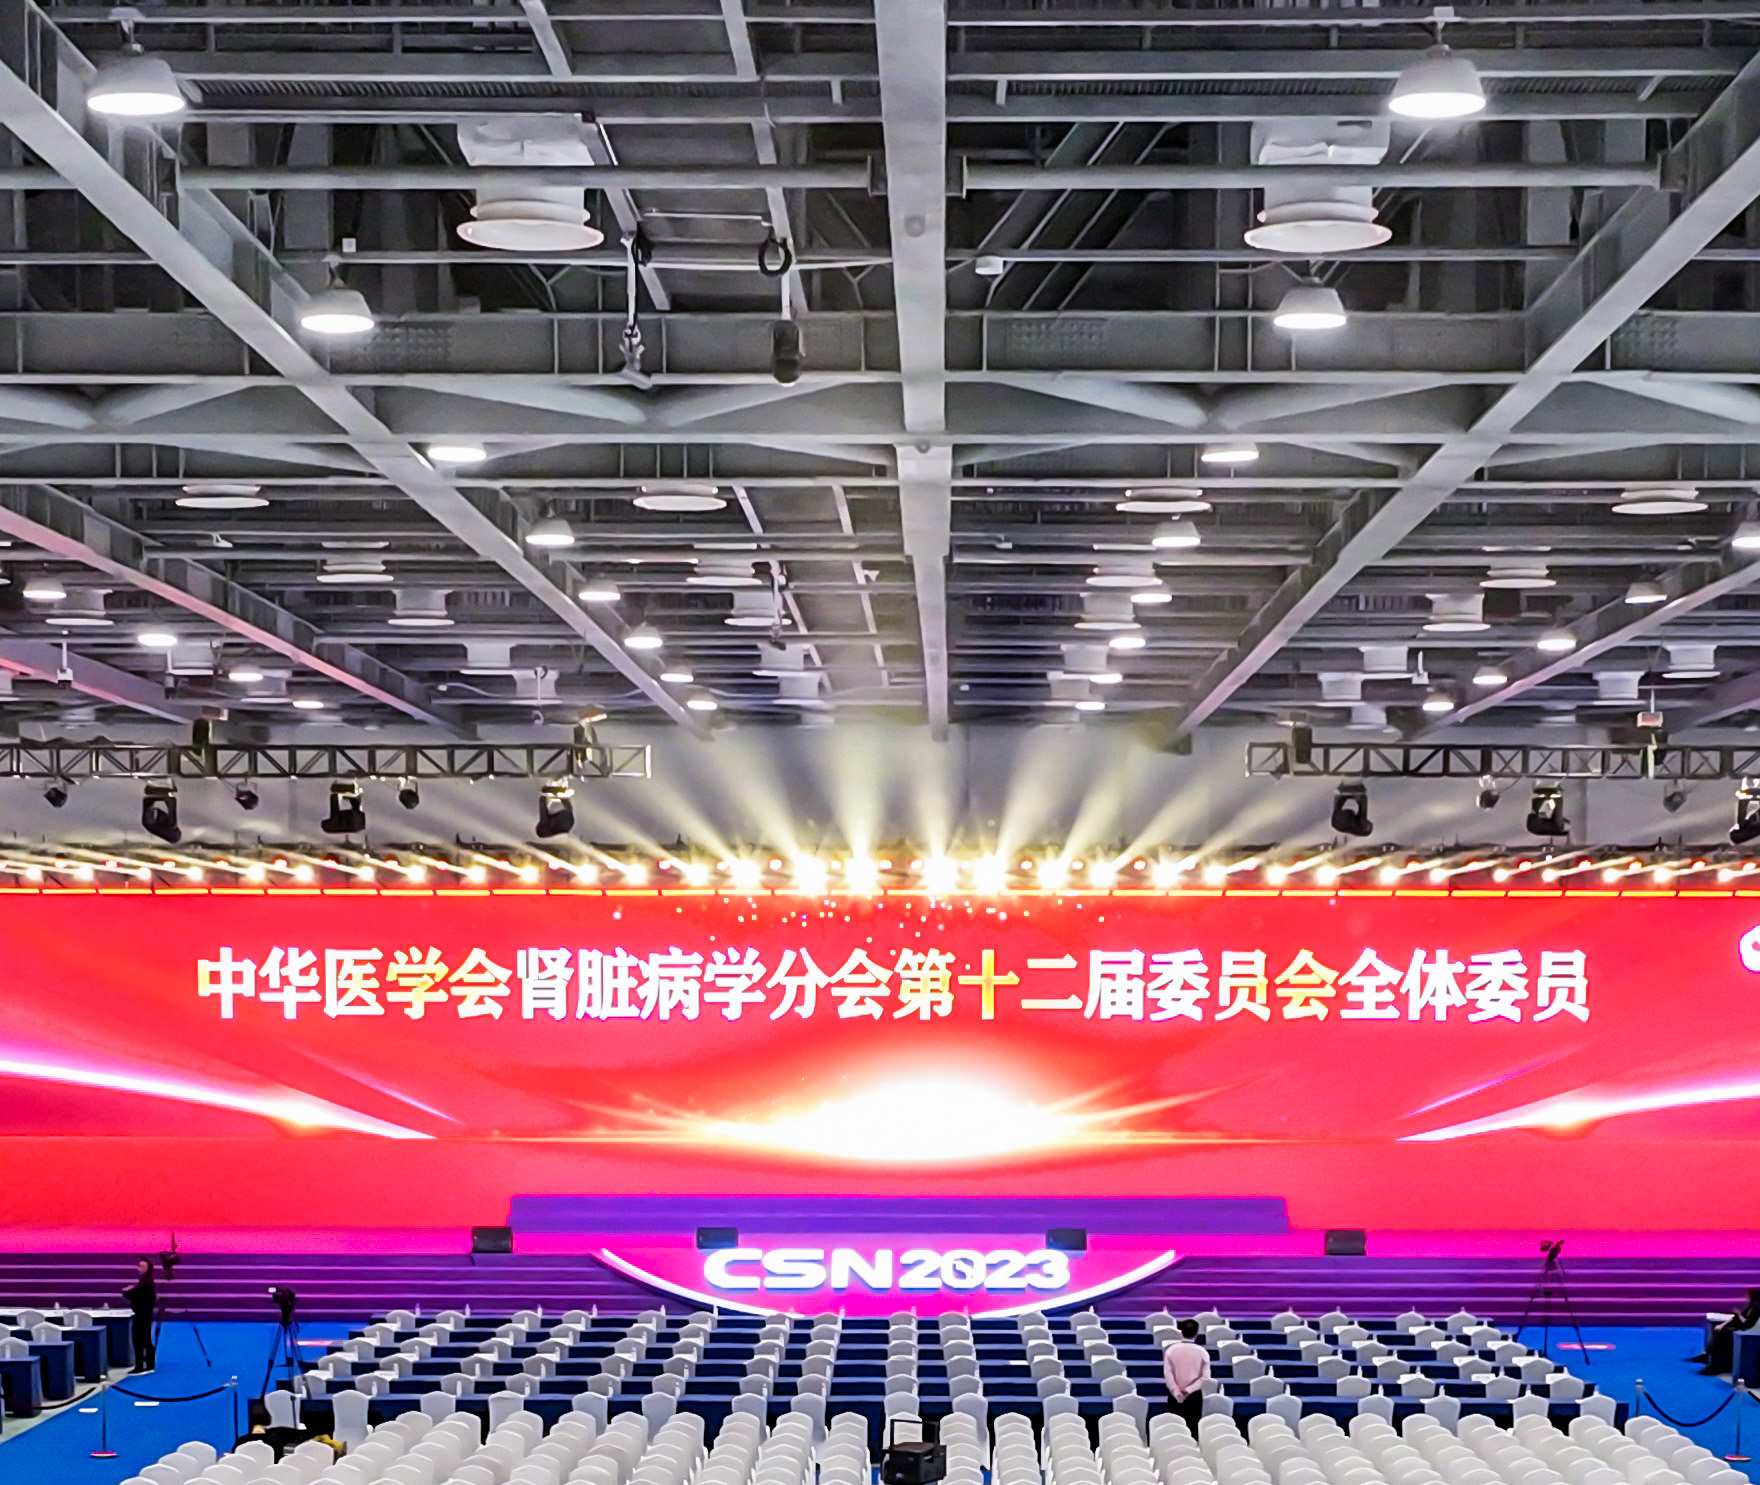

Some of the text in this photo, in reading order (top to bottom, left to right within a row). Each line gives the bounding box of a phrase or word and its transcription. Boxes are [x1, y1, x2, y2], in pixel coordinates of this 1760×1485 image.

[196, 945, 1590, 1022] 中华医学会肾脏病学分会第十二届委员会全体委员
